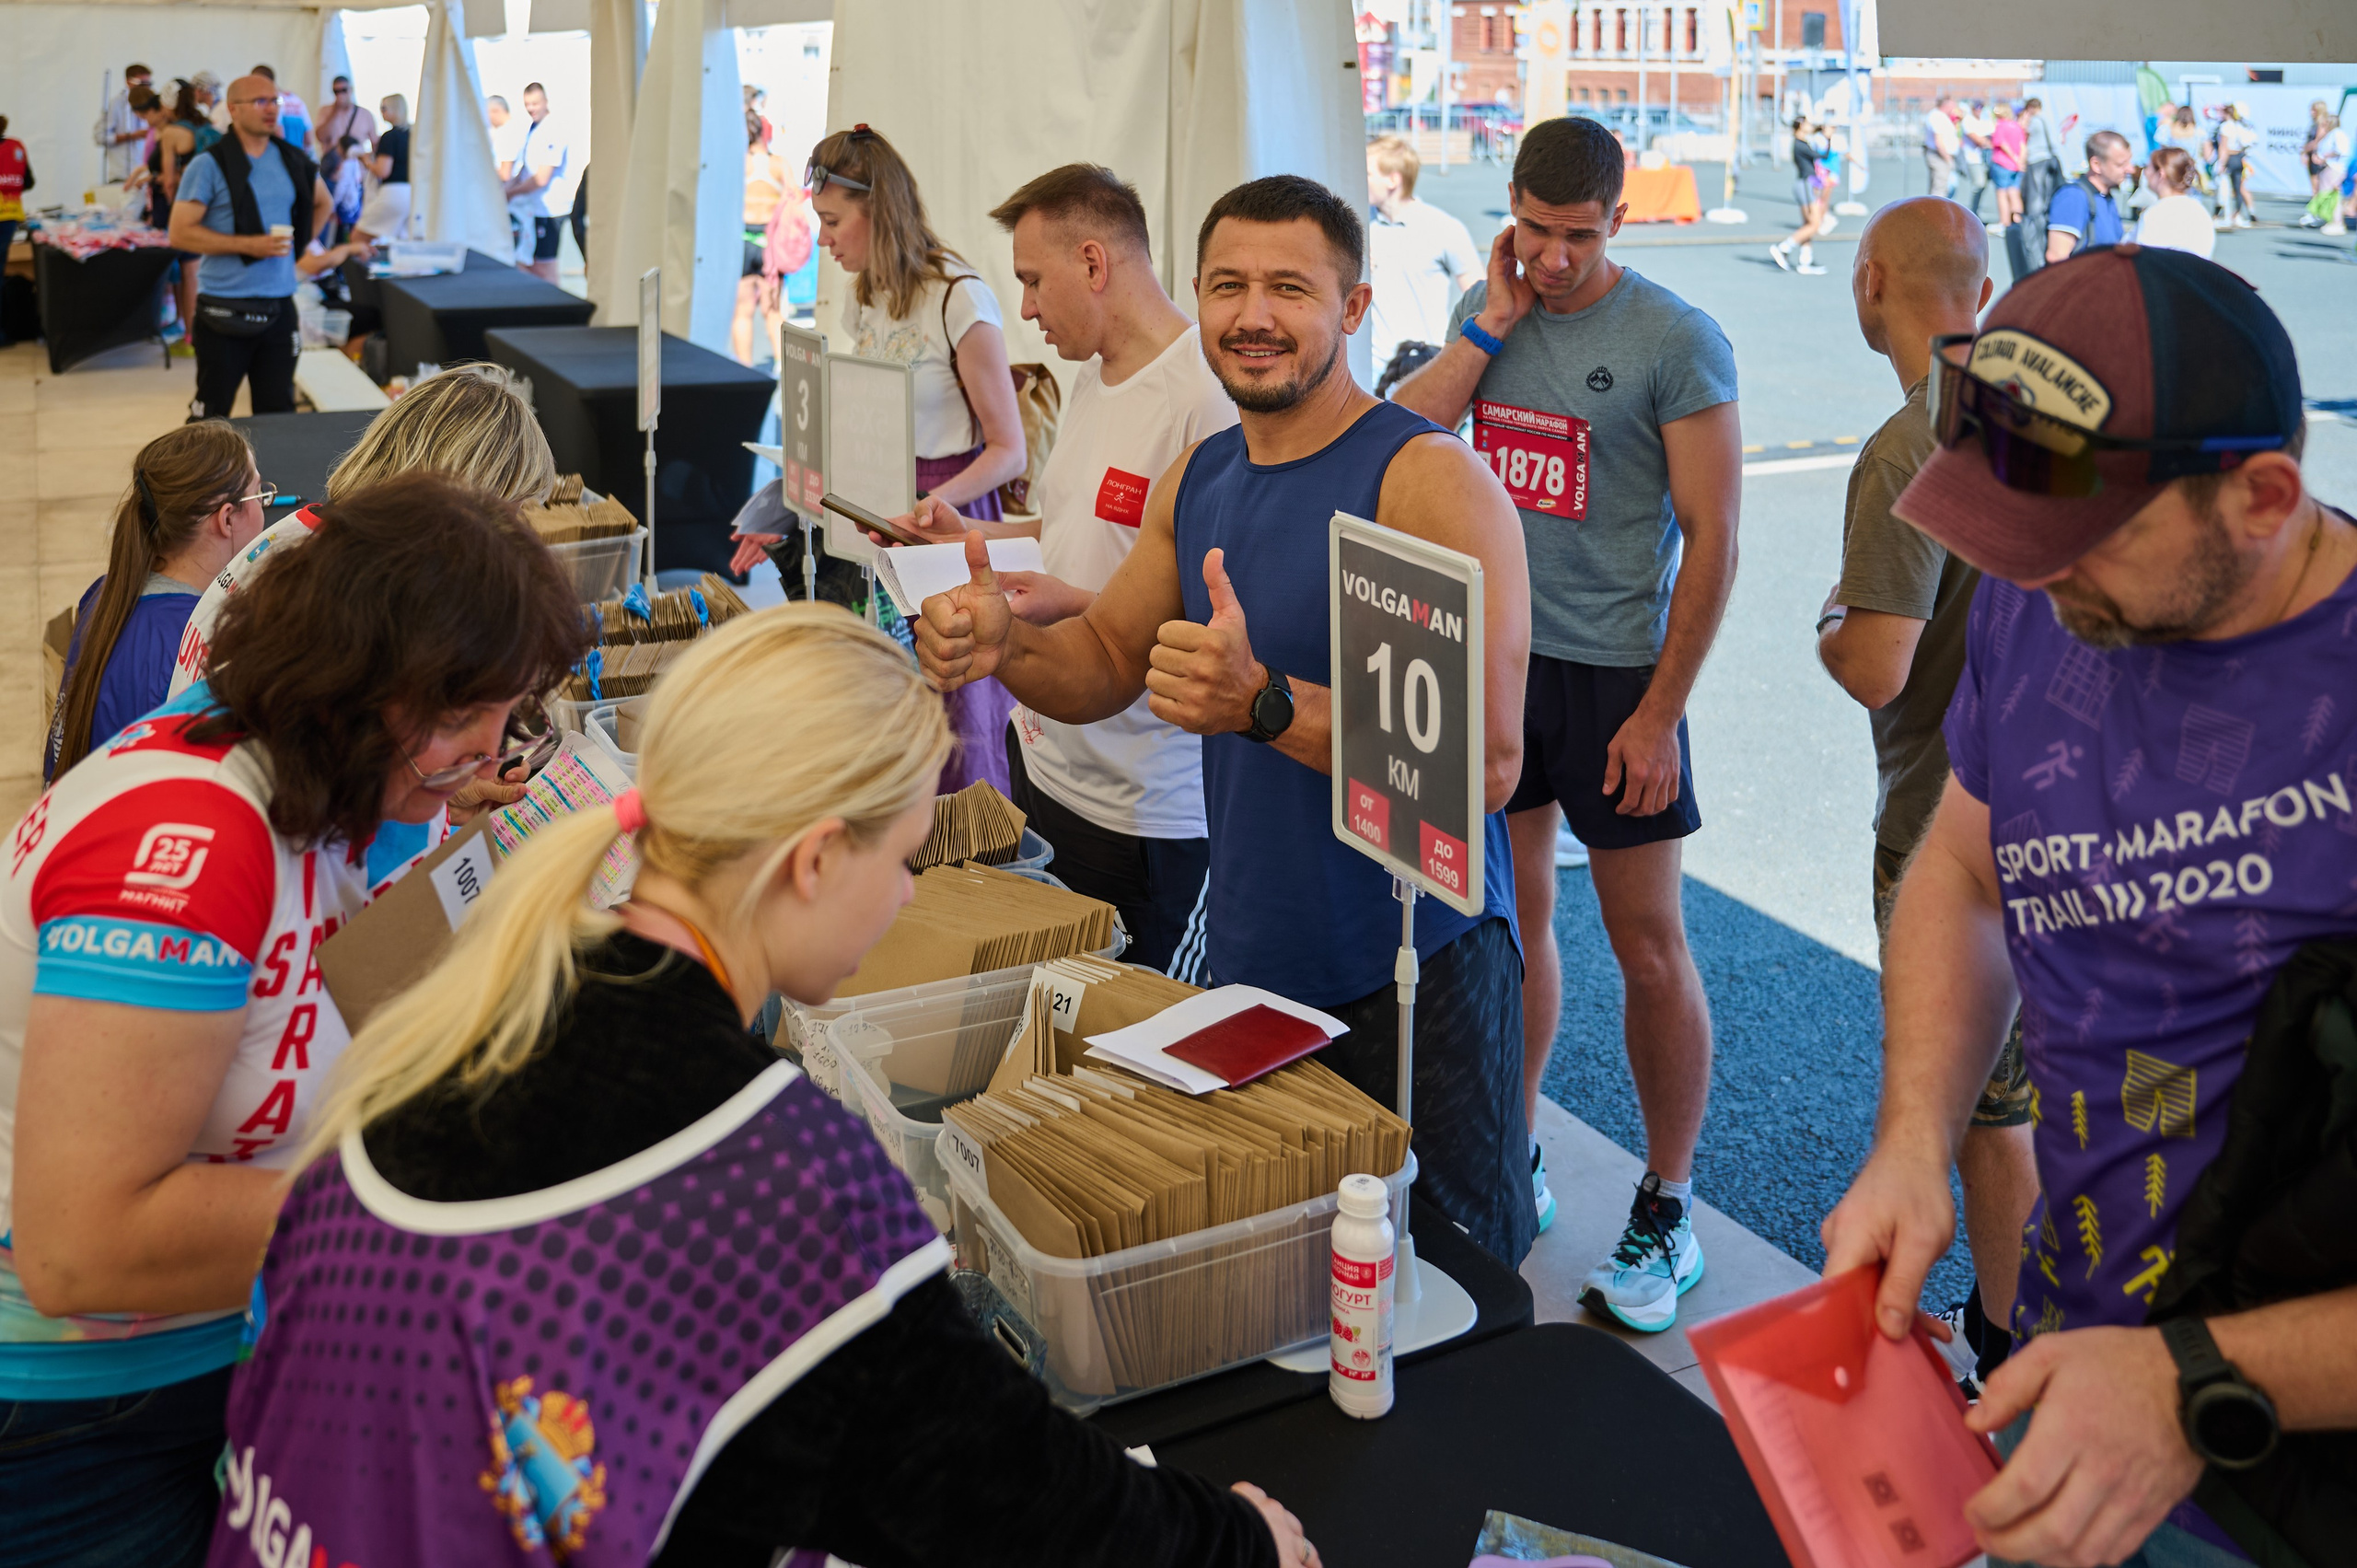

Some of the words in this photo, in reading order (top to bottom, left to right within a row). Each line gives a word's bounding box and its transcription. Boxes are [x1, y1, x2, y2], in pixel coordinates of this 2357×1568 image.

[2021, 348, 2101, 415] AVALANCHE
[796, 379, 809, 431] 3
[1482, 403, 1535, 424] САМАРСКИЙ
[1536, 417, 1568, 431] МАРАФОН
[1107, 480, 1142, 494] ЛОНГРАН
[1496, 447, 1565, 496] 1878
[1573, 433, 1585, 510] VOLGAMAN
[1113, 505, 1129, 514] ВДНХ
[1342, 569, 1462, 643] VOLGAMAN
[1366, 642, 1441, 753] 10
[1388, 755, 1419, 800] КМ
[1354, 814, 1381, 843] 1400
[154, 837, 192, 862] 25
[454, 857, 482, 904] 1007
[1428, 858, 1458, 889] 1599
[119, 889, 189, 915] МАГНИТ
[2007, 888, 2099, 936] TRAIL
[2148, 853, 2273, 912] 2020
[813, 1074, 823, 1086] 10
[952, 1134, 980, 1173] 7007
[1331, 1279, 1371, 1306] ОГУРТ
